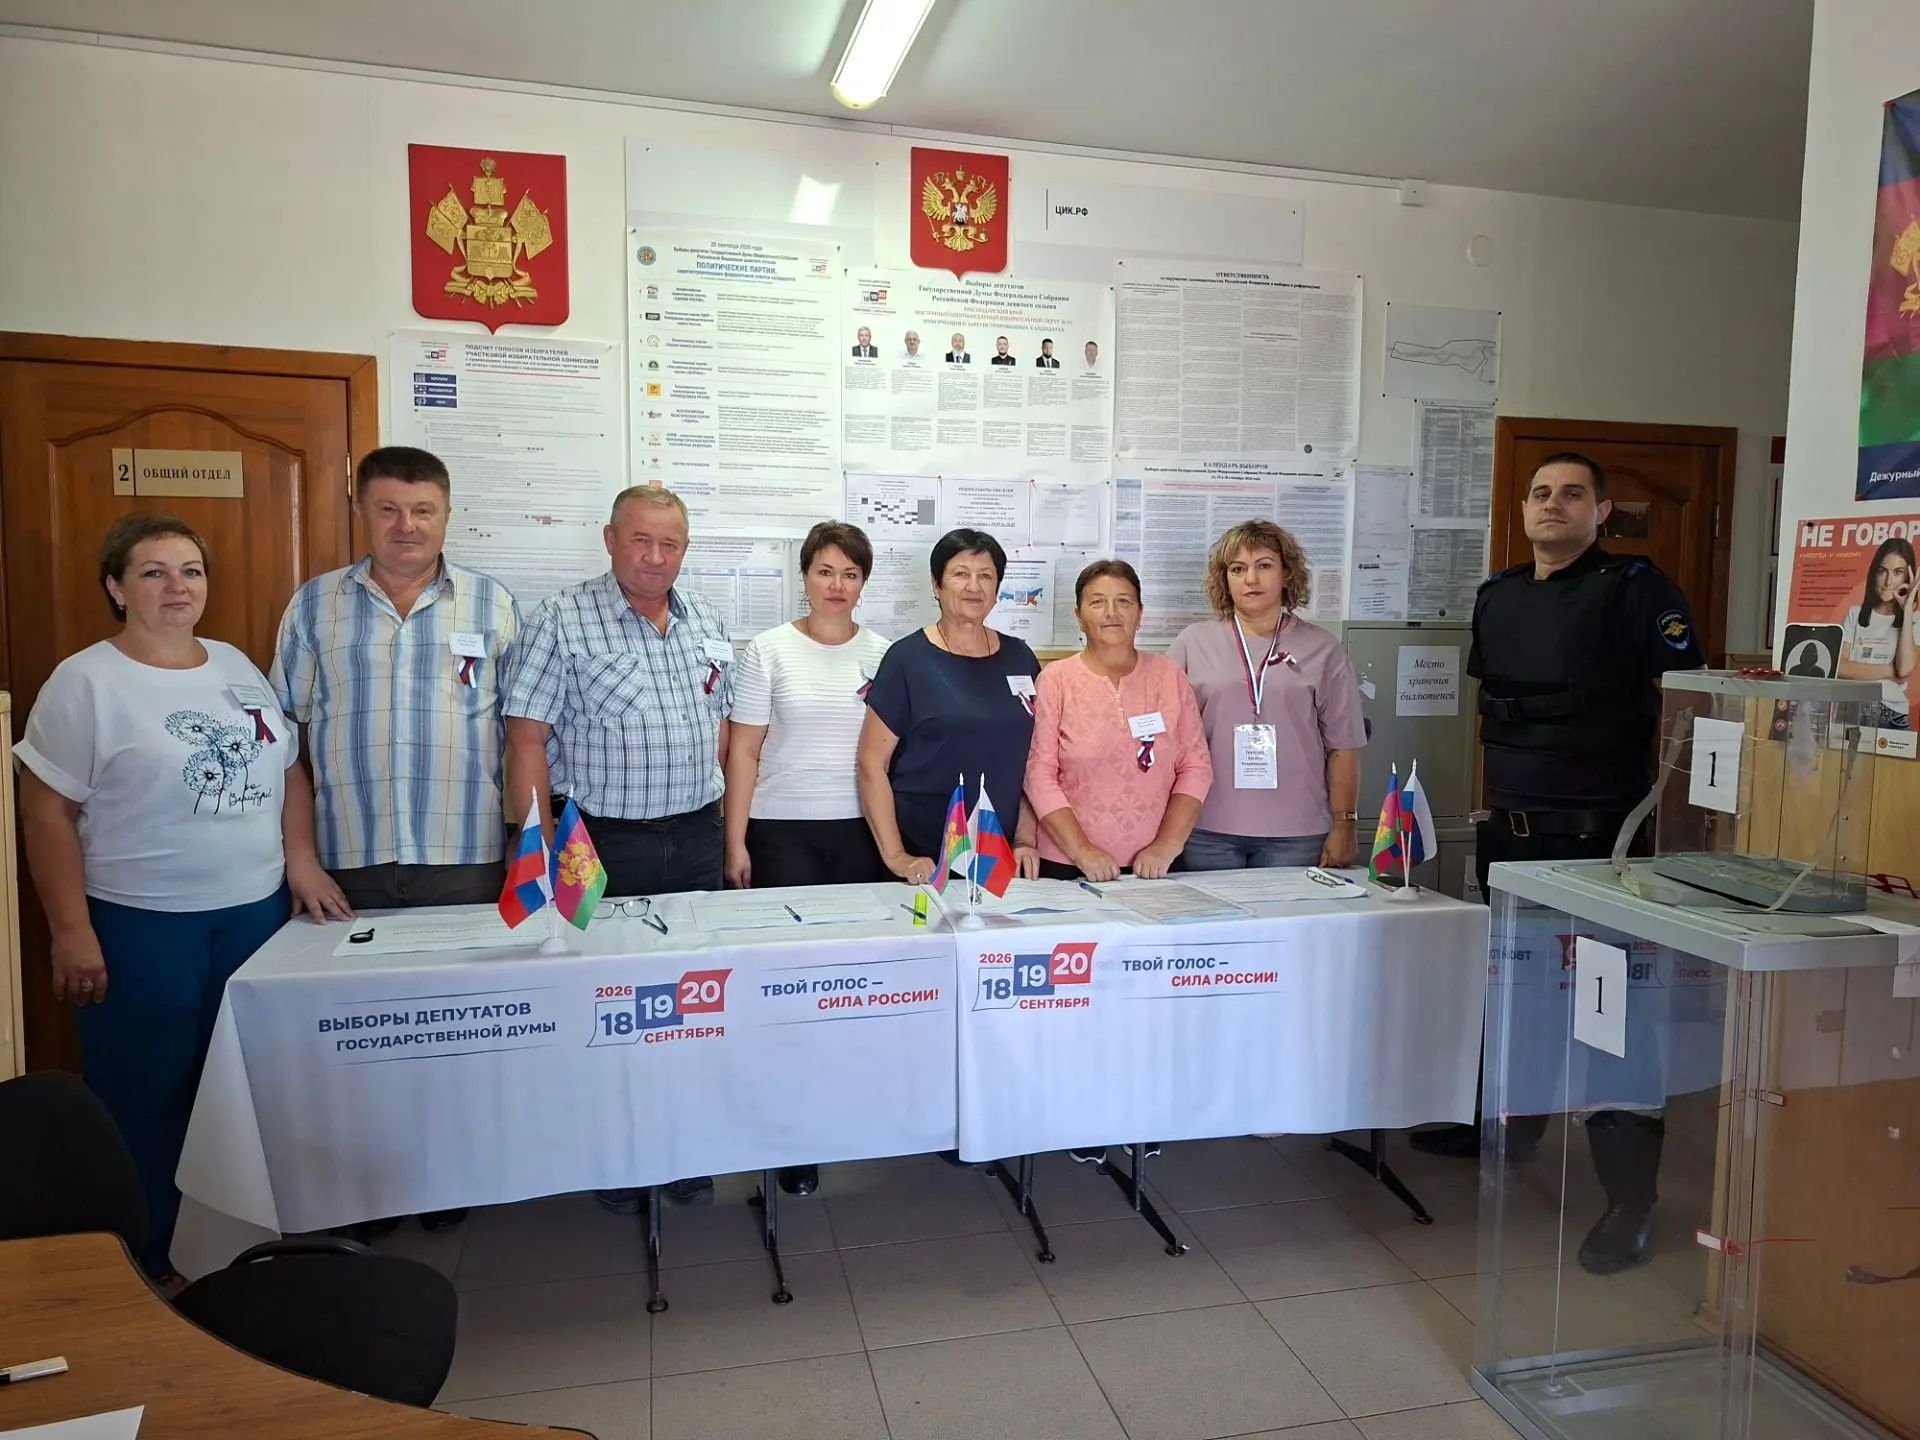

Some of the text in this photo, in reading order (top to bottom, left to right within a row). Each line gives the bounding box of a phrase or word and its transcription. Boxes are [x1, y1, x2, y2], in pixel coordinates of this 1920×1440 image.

[1055, 205, 1089, 217] ЦИК.РФ
[696, 262, 748, 272] ПОЛИТИЧЕСКИЕ
[918, 285, 972, 296] Государственной
[966, 279, 992, 288] Выборы
[932, 295, 968, 304] Российской
[508, 354, 560, 362] ИЗБИРАТЕЛЬНОЙ
[525, 348, 568, 356] ИЗБИРАТЕЛЕЙ
[118, 464, 231, 482] 2 ОБЩИЙ ОТДЕЛ
[1800, 525, 1834, 548] НЕ
[1414, 659, 1445, 669] Место
[1408, 678, 1449, 687] хранения
[1708, 751, 1718, 787] 1
[980, 953, 1012, 963] 2026
[1122, 956, 1163, 972] ТВОЙ
[1167, 957, 1215, 970] ГОЛОС
[982, 953, 1088, 1000] 18 19 20
[1172, 971, 1278, 988] СИЛА РОССИИ!
[595, 985, 633, 998] 2026
[761, 979, 807, 997] ТВОЙ
[812, 977, 868, 993] ГОЛОС
[817, 989, 939, 1010] СИЛА РОССИИ!
[1020, 997, 1090, 1010] СЕНТЯБРЯ
[1595, 976, 1605, 1016] 1
[600, 980, 721, 1036] 18 19 20
[318, 1001, 532, 1032] ВЫБОРЫ ДЕПУТАТОВ
[336, 1022, 556, 1051] ГОСУДАРСТВЕННОЙ ДУМЫ
[644, 1026, 725, 1044] СЕНТЯБРЯ
